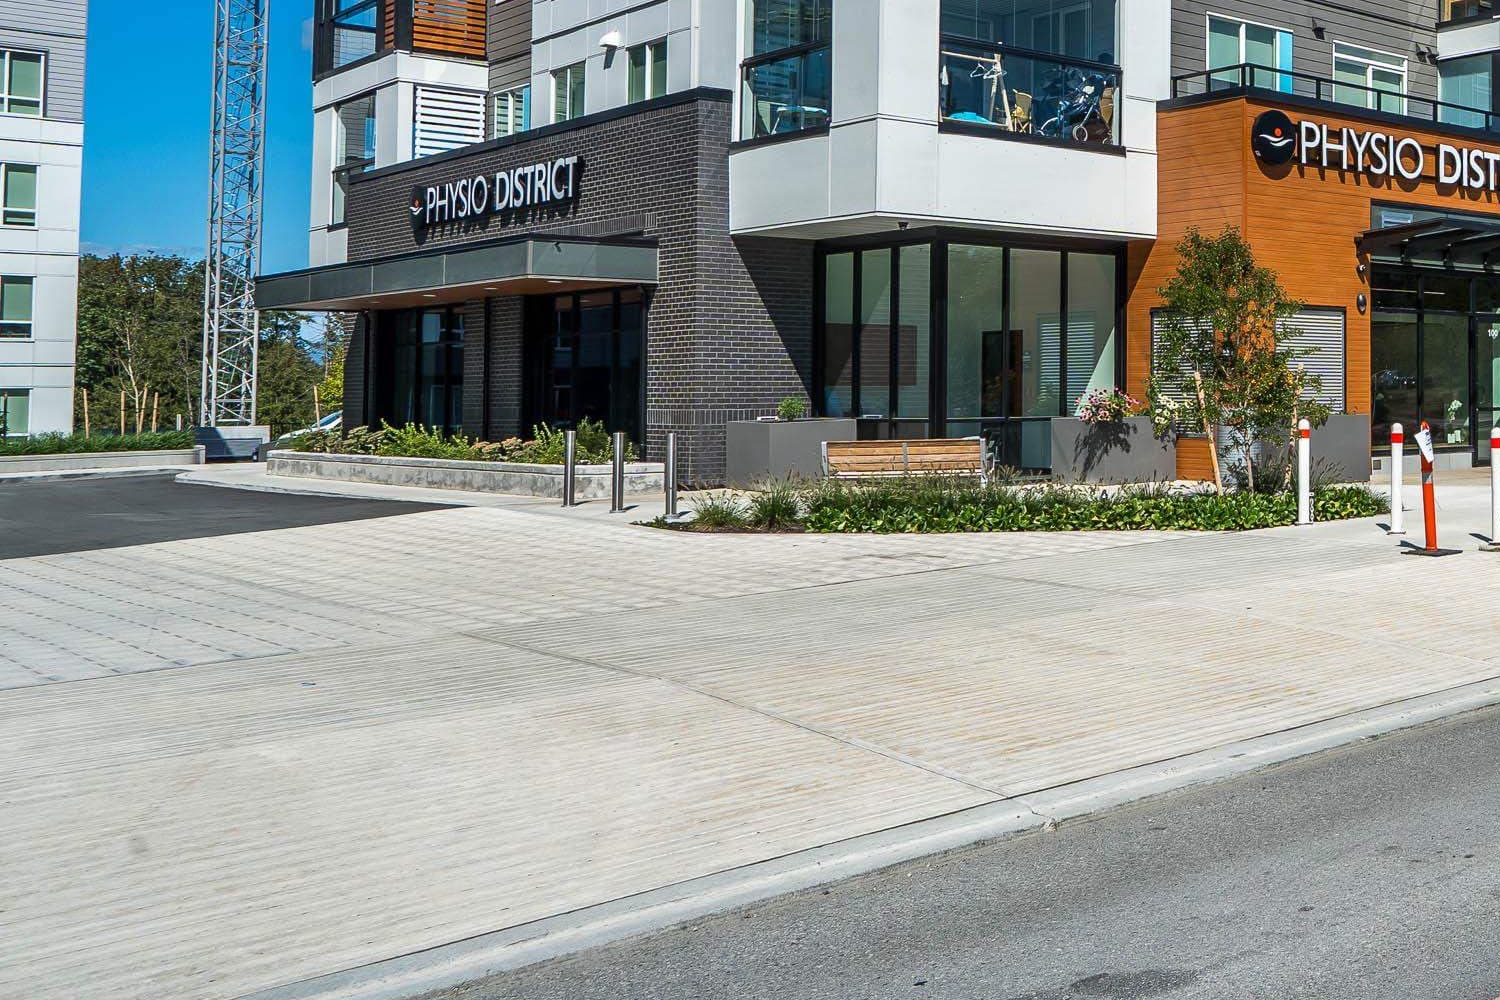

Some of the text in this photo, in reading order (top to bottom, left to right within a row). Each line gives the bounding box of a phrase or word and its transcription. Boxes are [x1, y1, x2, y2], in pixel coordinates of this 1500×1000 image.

[1300, 120, 1424, 179] PHYSIO
[426, 155, 577, 224] PHYSIO DISTRICT
